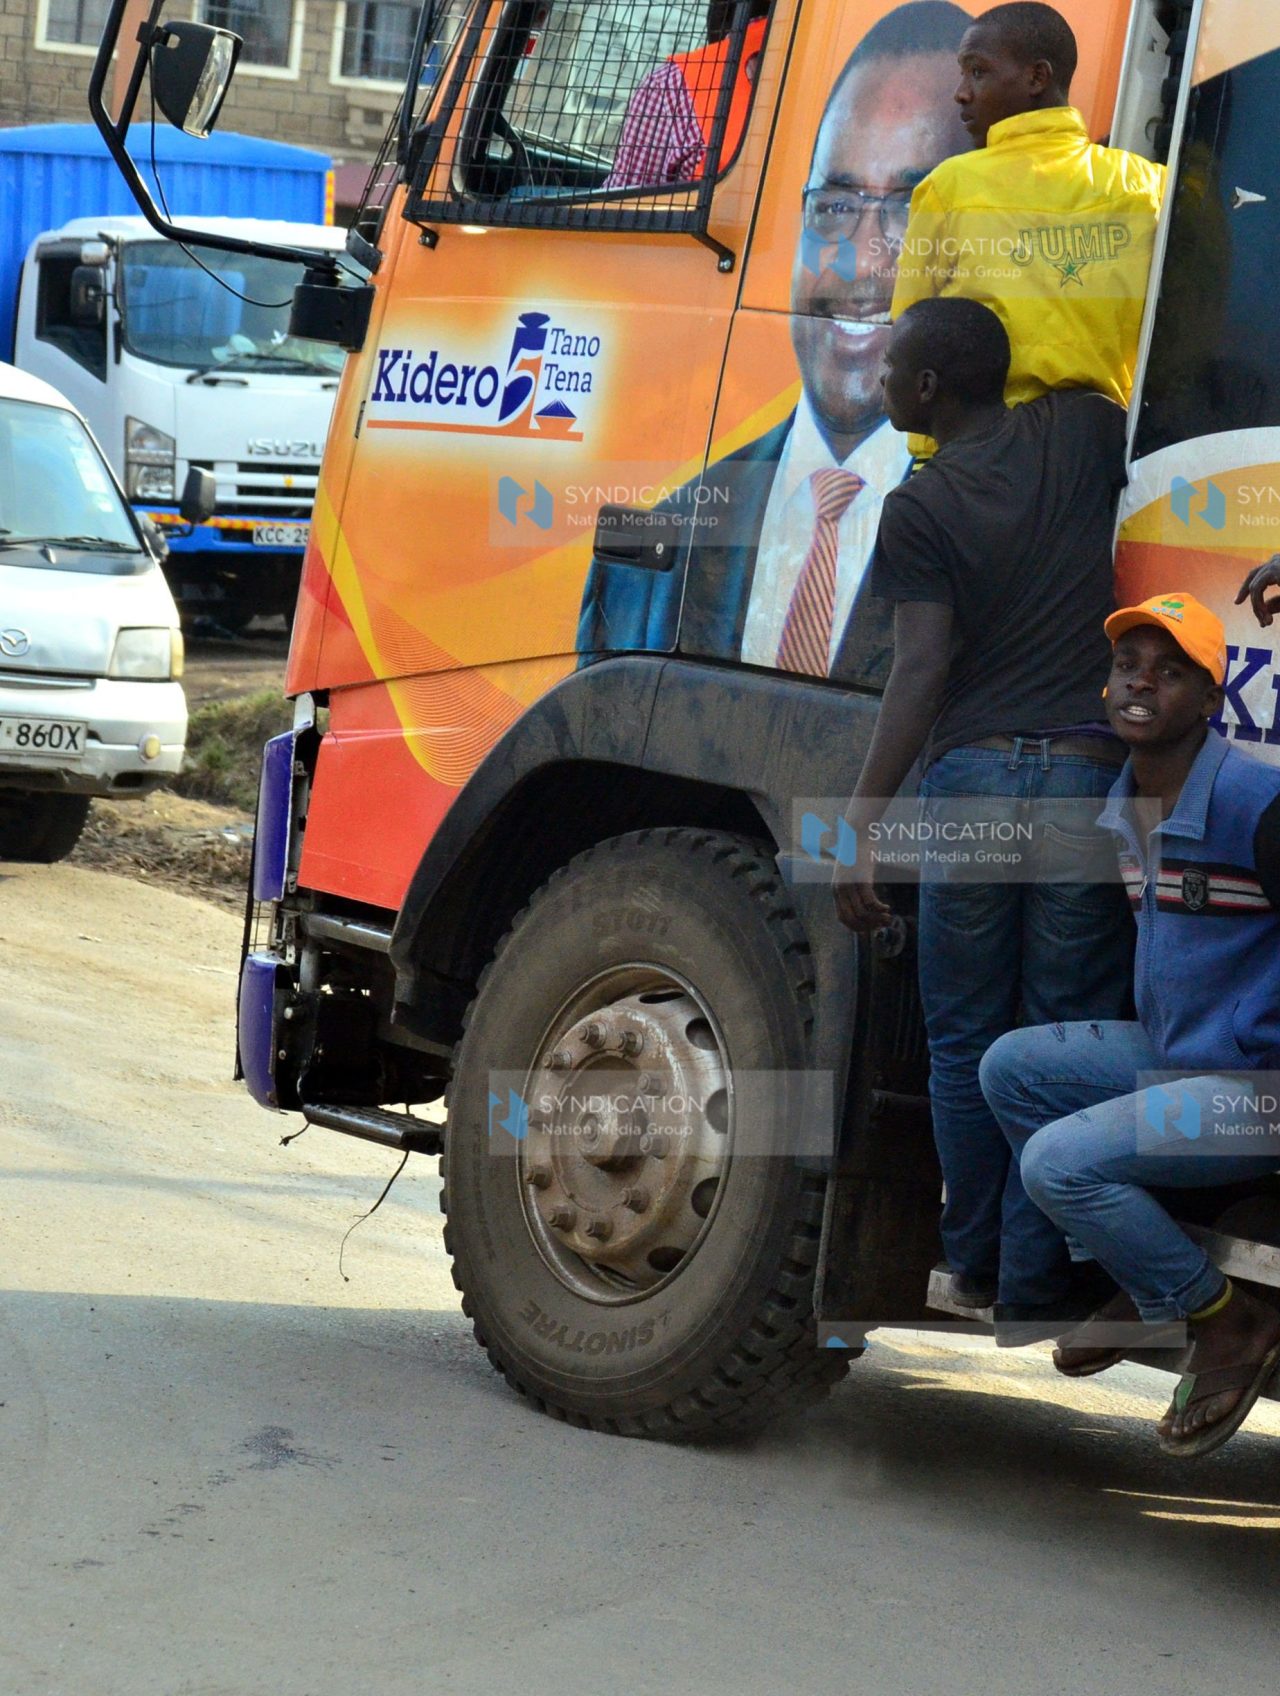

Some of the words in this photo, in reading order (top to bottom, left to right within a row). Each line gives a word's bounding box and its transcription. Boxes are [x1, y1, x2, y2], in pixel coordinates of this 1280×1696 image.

[1010, 222, 1132, 267] JUMP
[550, 327, 601, 357] Tano
[371, 348, 499, 408] Kidero
[544, 363, 593, 393] Tena
[247, 440, 323, 458] ISUZU
[254, 527, 284, 542] KCC
[16, 723, 81, 750] 860X
[516, 1299, 657, 1356] SINOTYRE
